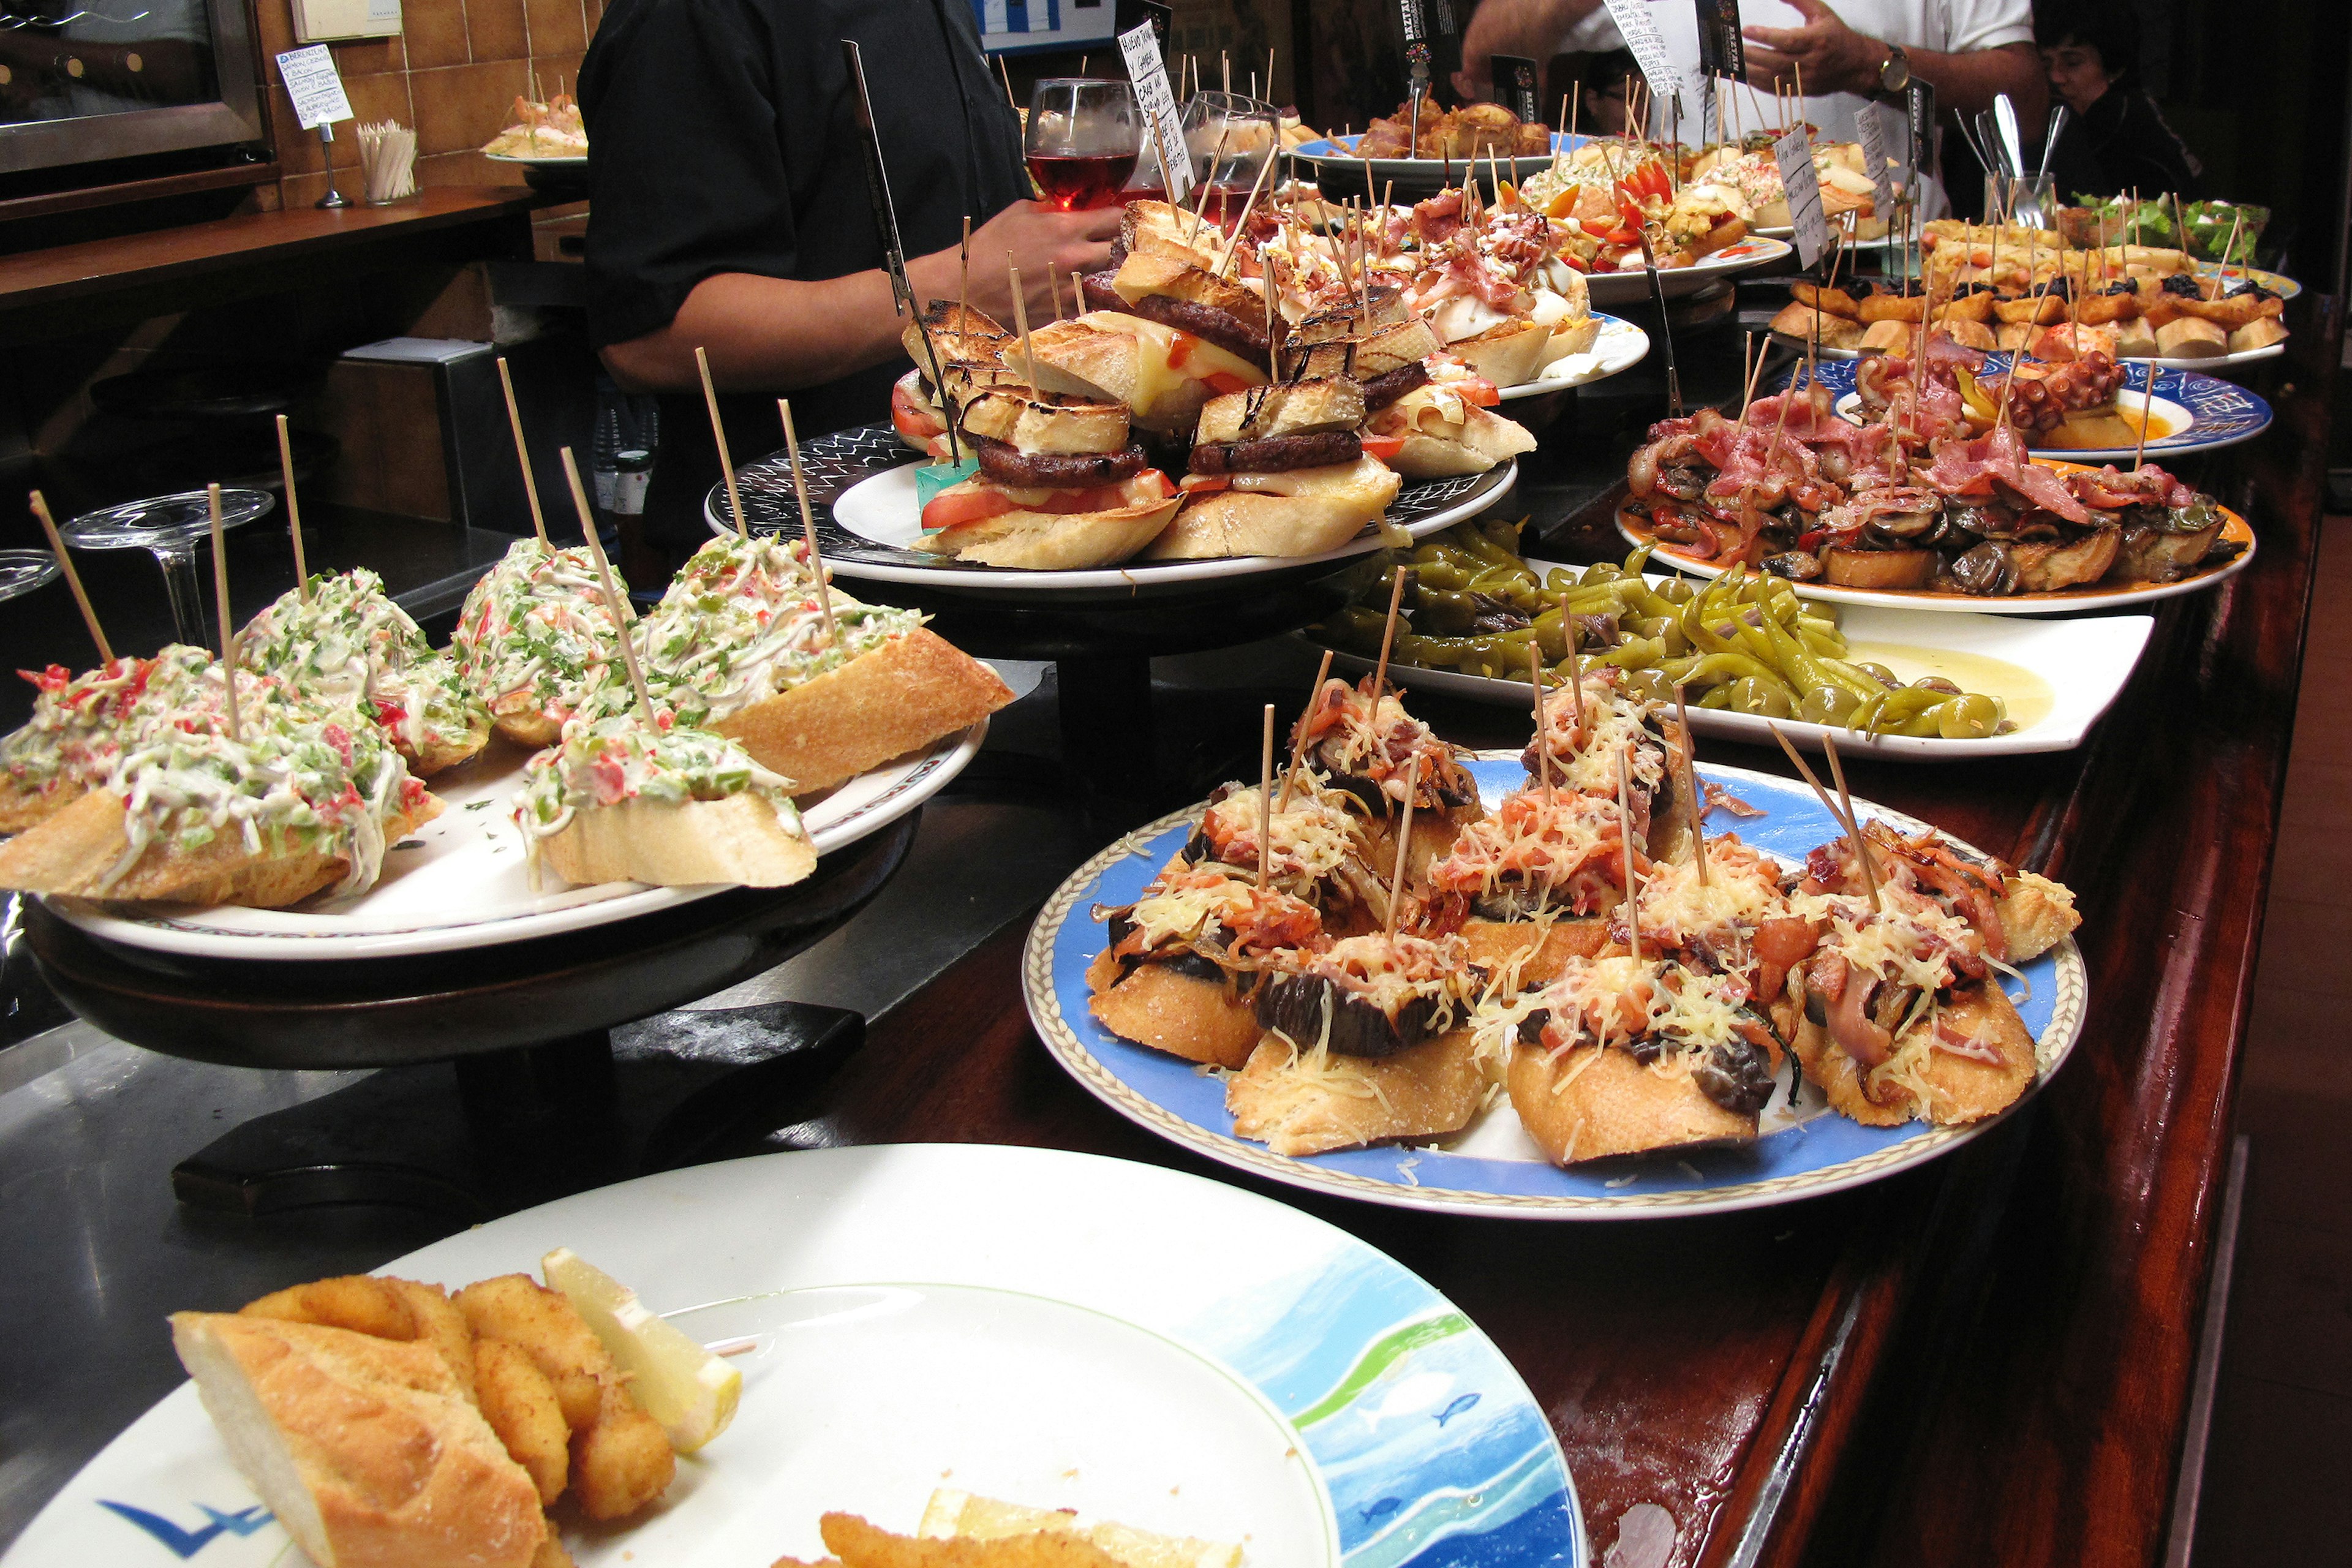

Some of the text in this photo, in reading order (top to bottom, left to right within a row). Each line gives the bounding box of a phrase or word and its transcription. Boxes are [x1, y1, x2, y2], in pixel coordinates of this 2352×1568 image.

[1728, 26, 1740, 72] BAZTAN
[1139, 74, 1162, 102] CRAB AND
[1526, 91, 1535, 122] BAZTA
